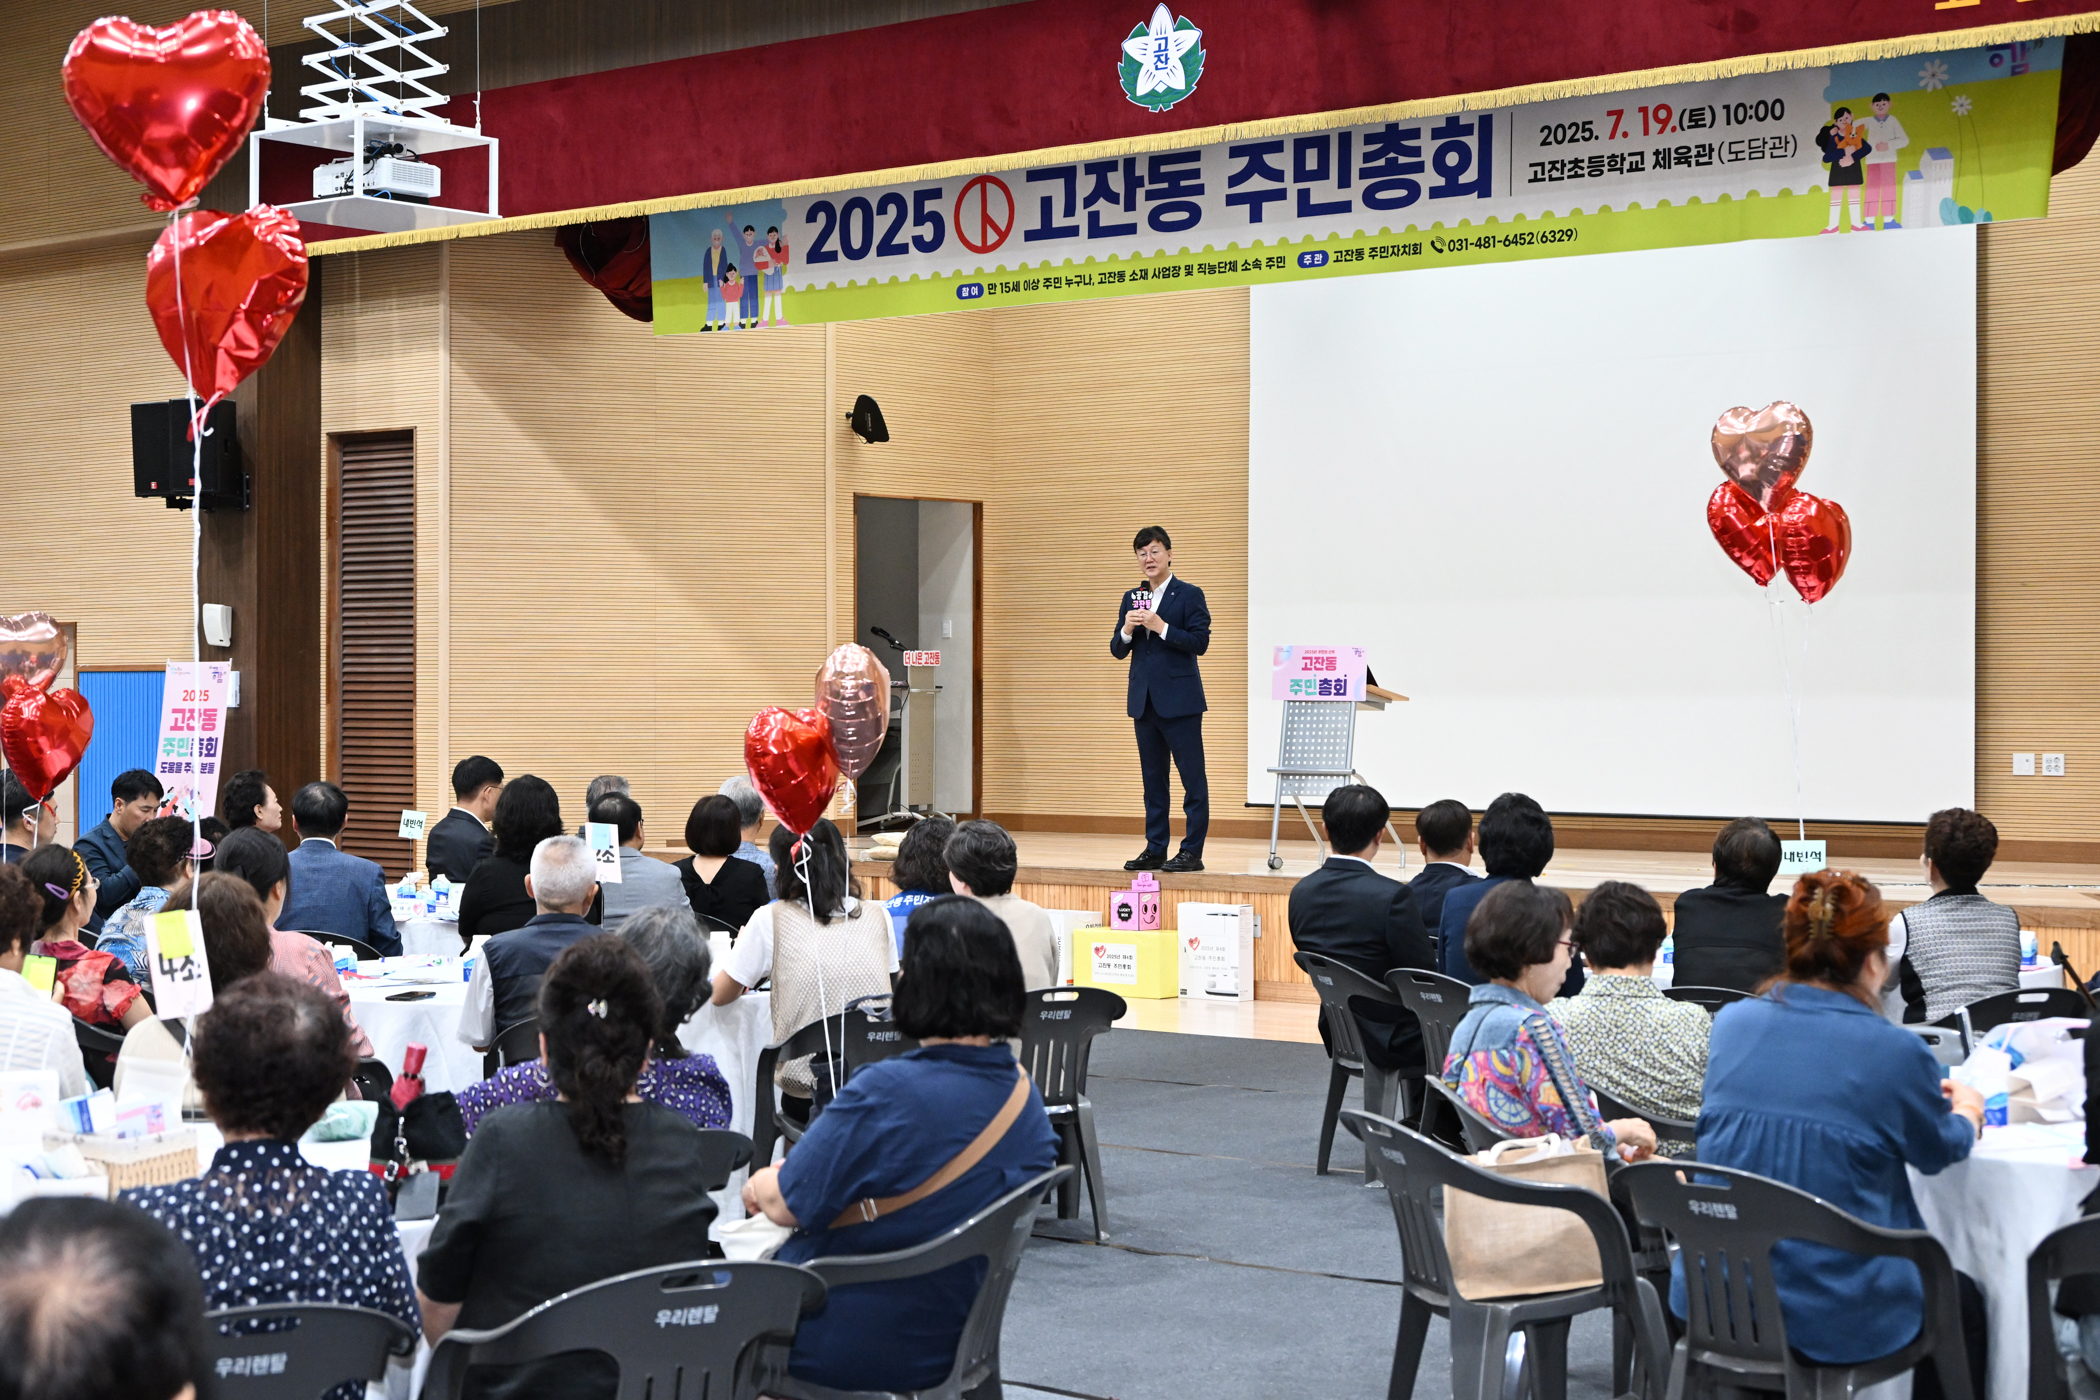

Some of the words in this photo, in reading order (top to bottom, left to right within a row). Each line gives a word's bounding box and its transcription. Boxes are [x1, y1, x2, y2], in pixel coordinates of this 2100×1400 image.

[1153, 36, 1170, 71] 고잔
[1539, 120, 1600, 146] 2025.
[1605, 108, 1629, 141] 7.
[1722, 98, 1785, 126] 10:00
[1527, 150, 1645, 184] 고잔초등학교
[805, 186, 946, 265] 2025
[1023, 149, 1205, 243] 고잔동
[1225, 113, 1493, 224] 주민총회
[1333, 247, 1365, 264] 고잔동
[1368, 241, 1422, 260] 주민자치회
[987, 283, 997, 296] 만
[1000, 280, 1021, 294] 15세
[1022, 278, 1040, 292] 이상
[1042, 276, 1063, 290] 주민
[1065, 273, 1095, 288] 누구나,
[1098, 270, 1126, 285] 고잔동
[1128, 268, 1149, 282] 소재
[1151, 265, 1182, 280] 사업장
[1184, 264, 1194, 277] 및
[1197, 259, 1238, 276] 직능단체
[1240, 257, 1262, 272] 소속
[1265, 255, 1287, 270] 주민
[1301, 656, 1337, 671] 고잔동
[1289, 674, 1347, 697] 주민총회
[402, 818, 423, 830] 내빈석
[1784, 851, 1822, 863] 내빈석
[1039, 1009, 1072, 1021] 우리렌탈
[654, 1302, 719, 1329] 우리렌탈
